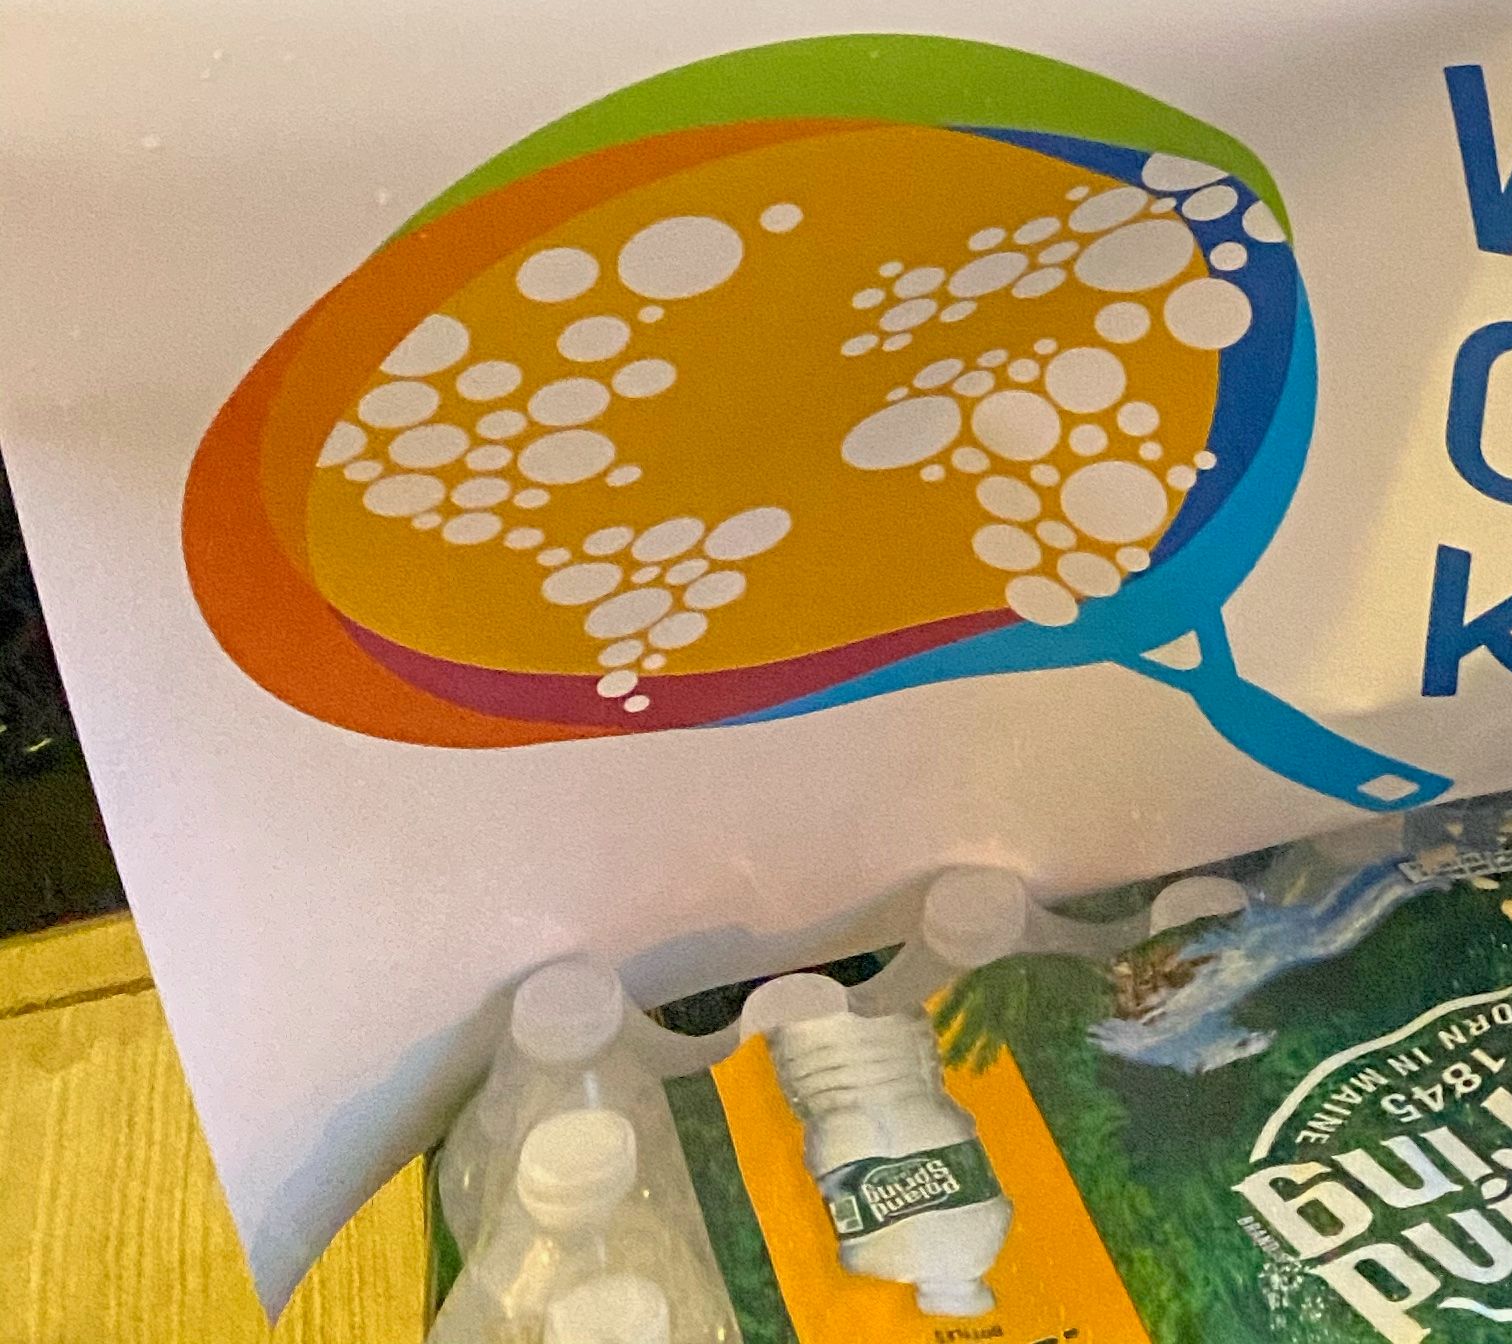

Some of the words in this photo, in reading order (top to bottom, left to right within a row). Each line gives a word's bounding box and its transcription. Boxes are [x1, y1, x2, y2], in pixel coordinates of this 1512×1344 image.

[1380, 1047, 1507, 1125] 1845
[1388, 1046, 1434, 1079] IN
[1294, 1066, 1391, 1146] MAINE
[862, 1159, 950, 1204] Spring
[869, 1176, 961, 1223] Poland
